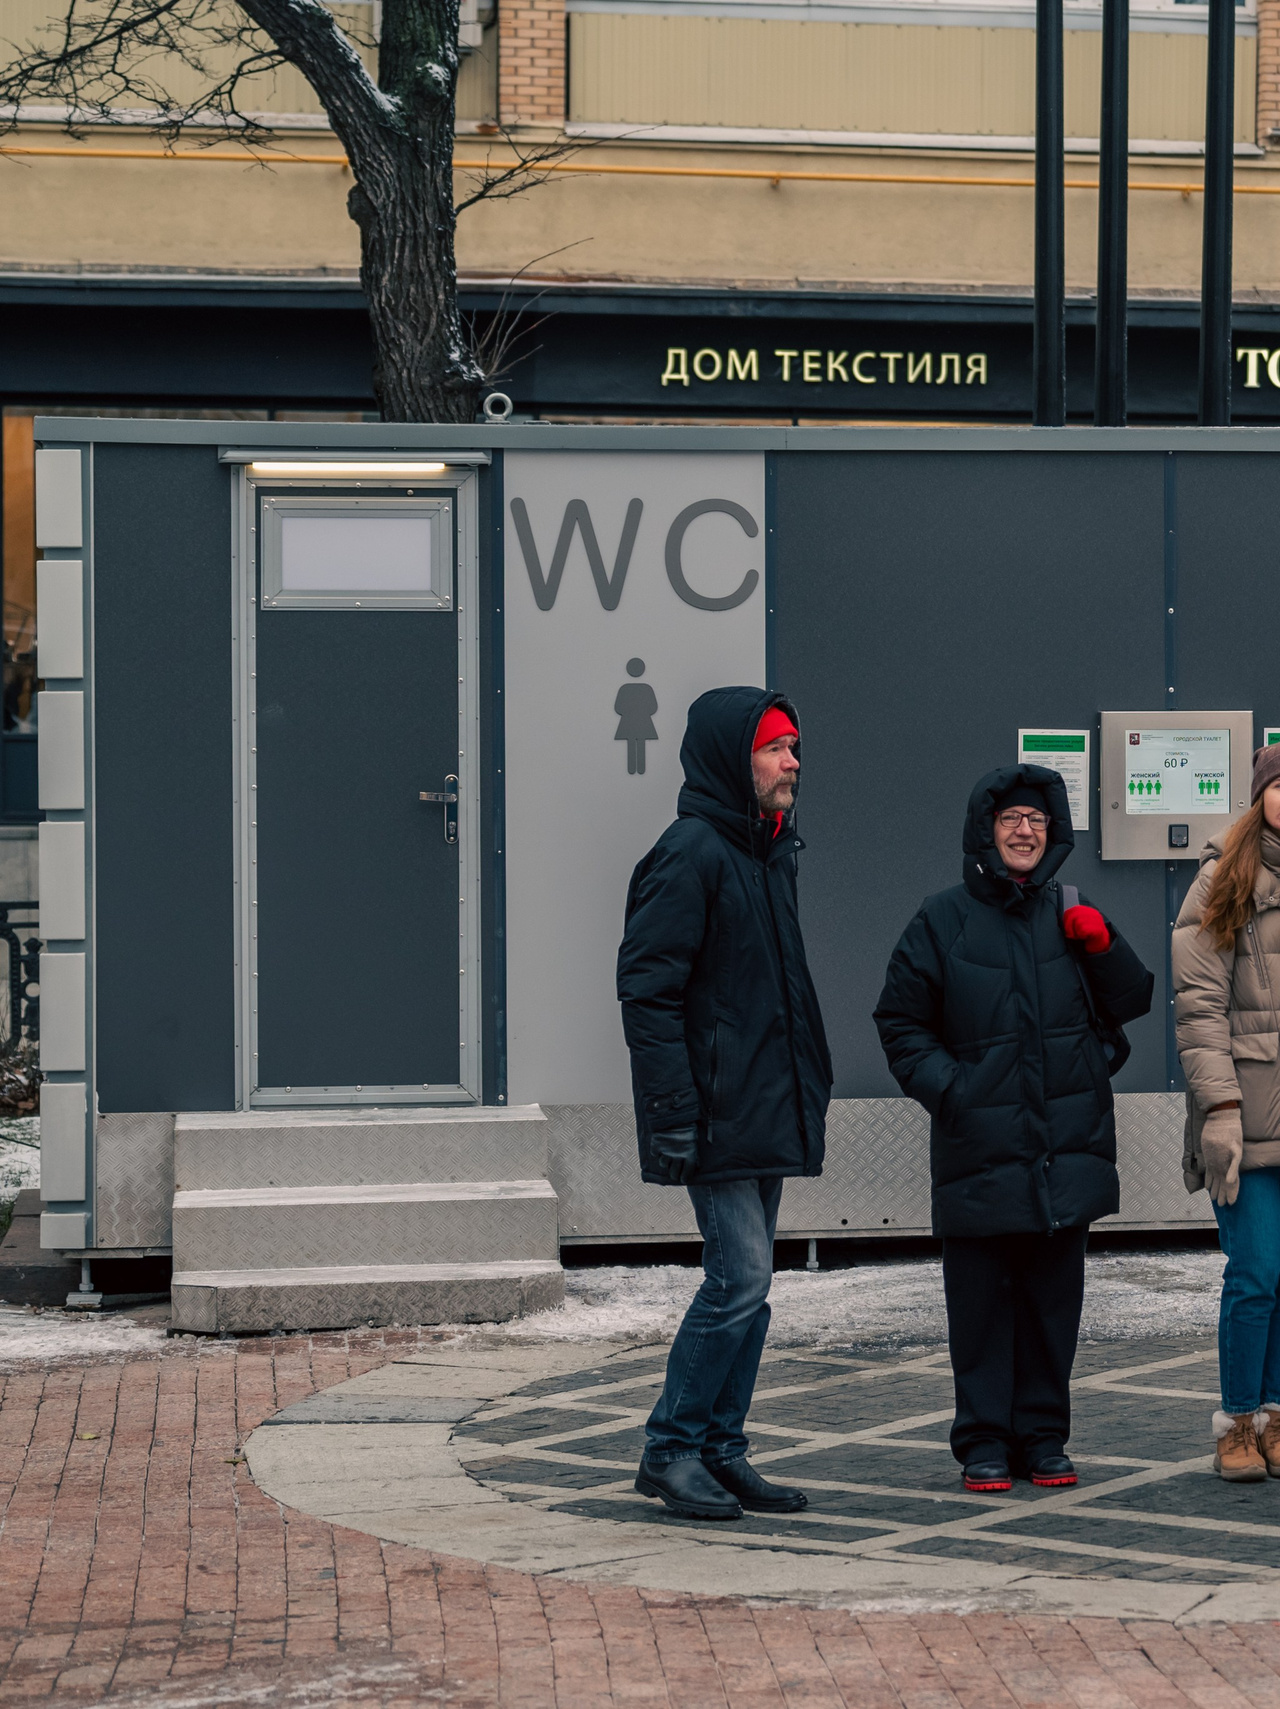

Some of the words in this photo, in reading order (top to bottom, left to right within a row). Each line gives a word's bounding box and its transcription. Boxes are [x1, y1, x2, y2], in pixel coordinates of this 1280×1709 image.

[661, 348, 760, 387] ДОМ
[774, 349, 988, 385] ТЕКСТИЛЯ
[510, 497, 759, 611] WC
[1164, 758, 1177, 768] 60
